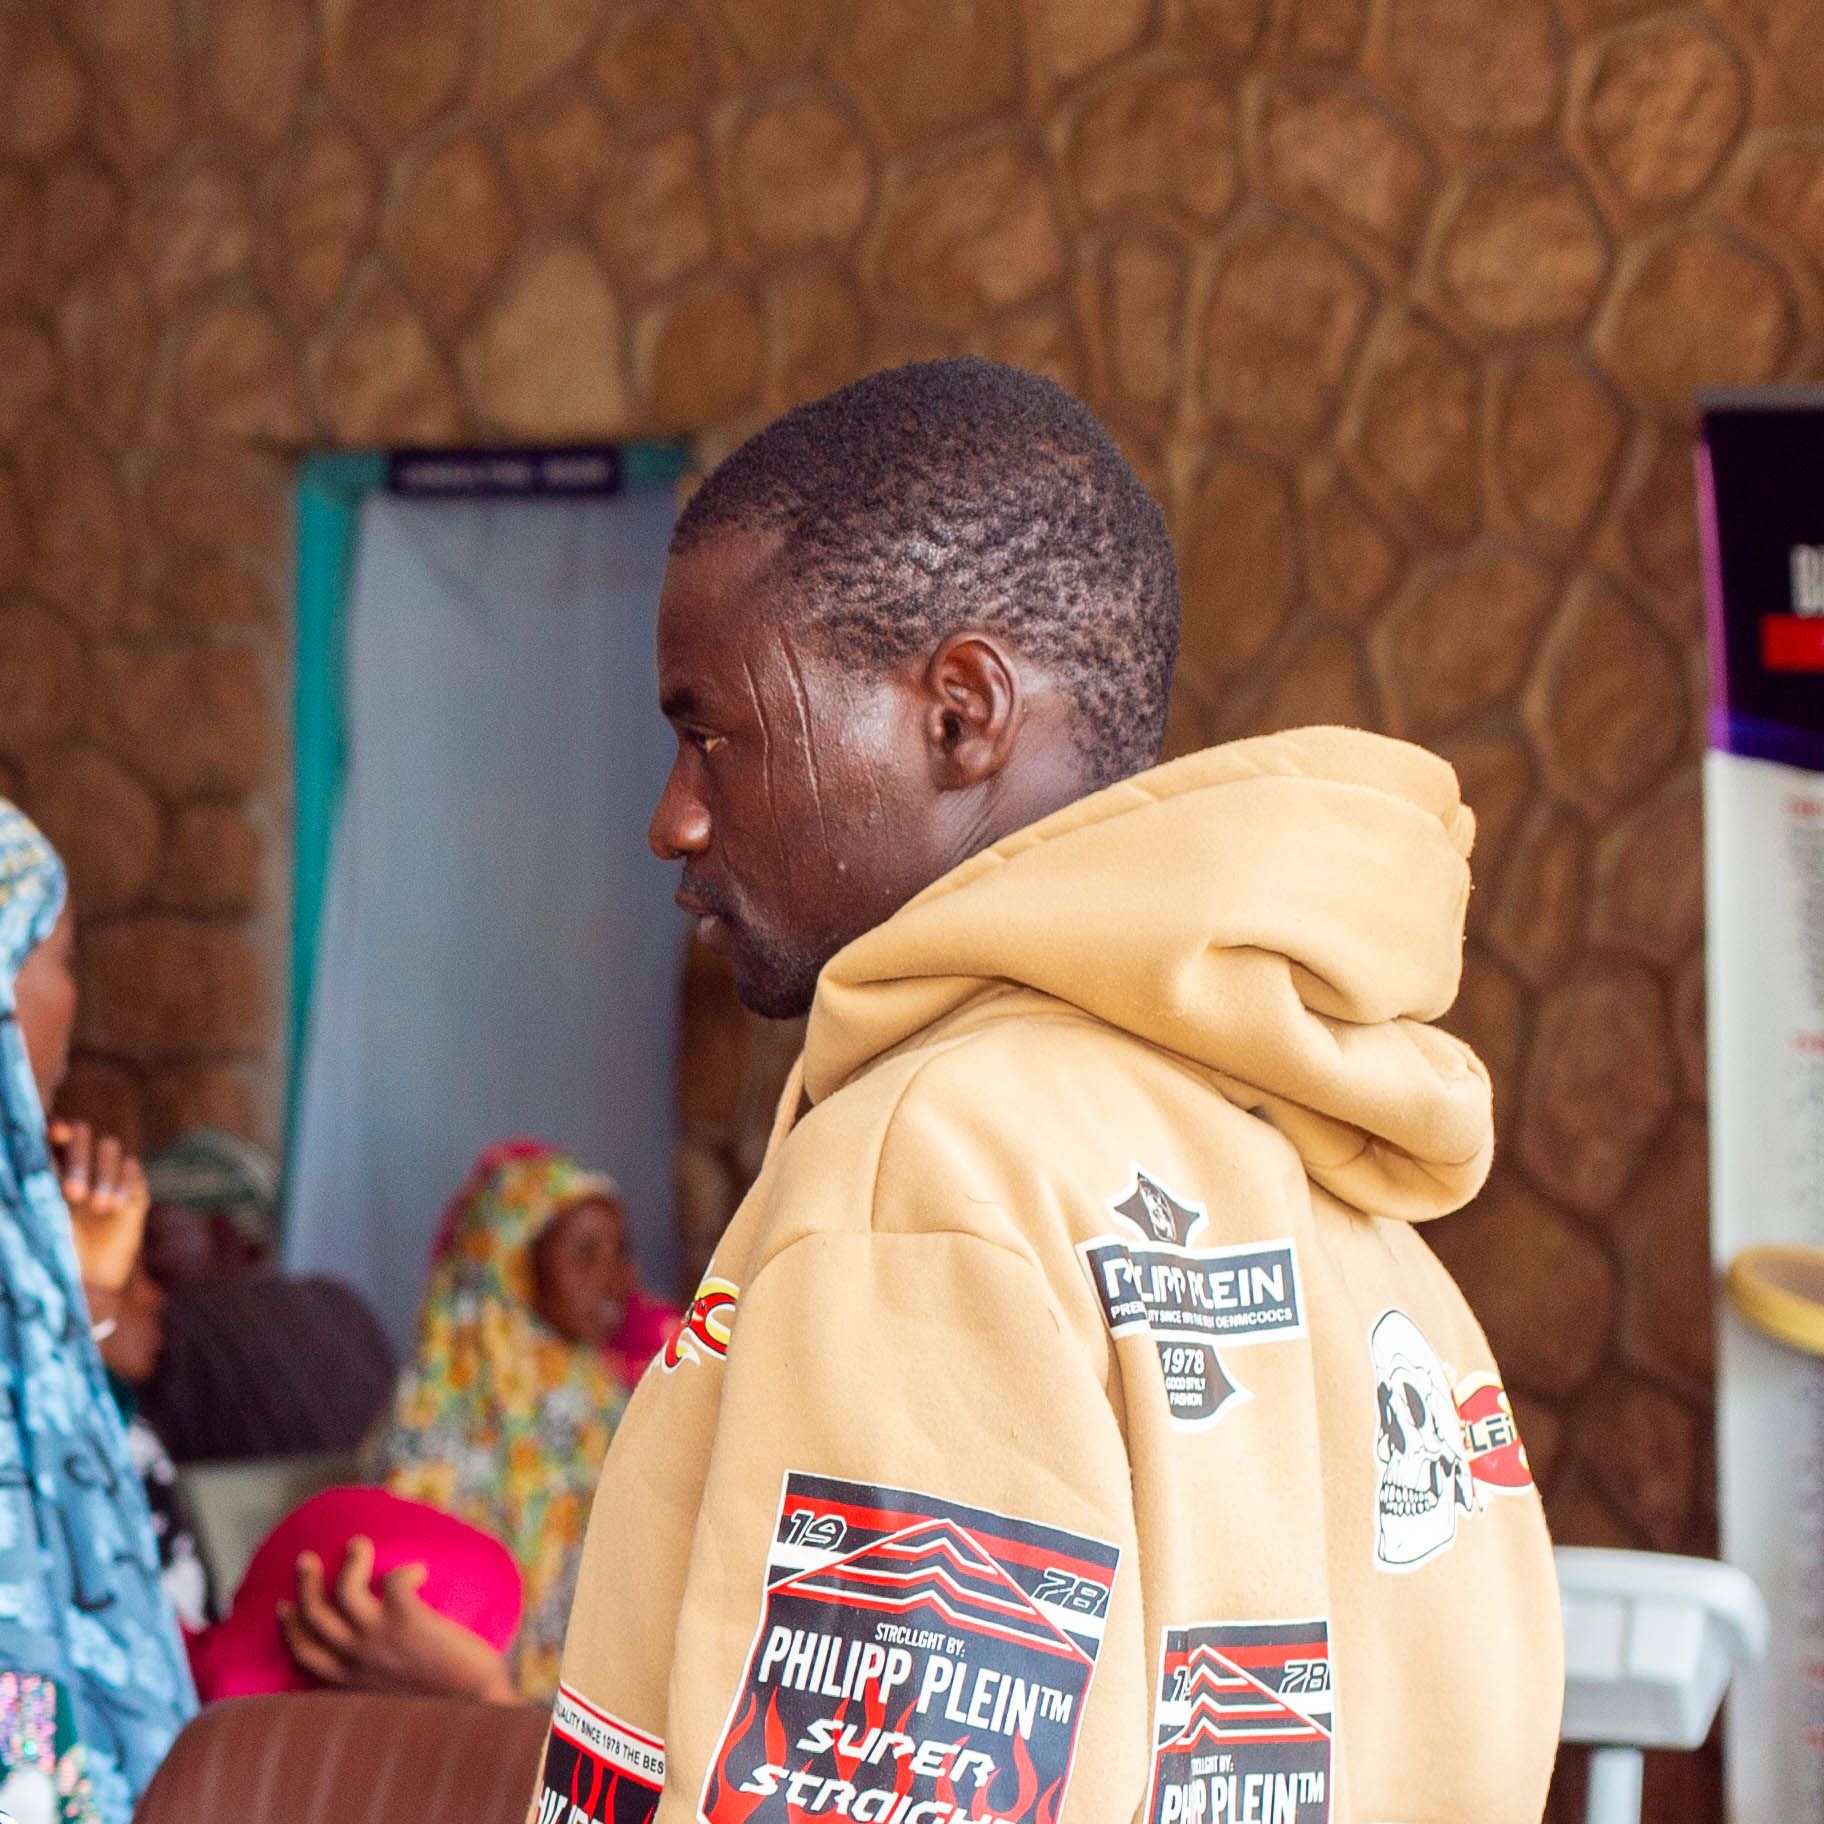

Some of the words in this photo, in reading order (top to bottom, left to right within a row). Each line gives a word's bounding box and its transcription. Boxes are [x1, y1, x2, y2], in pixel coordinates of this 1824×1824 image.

[1162, 1348, 1205, 1374] 1978
[784, 1510, 848, 1550] 19
[1030, 1568, 1110, 1616] 78
[758, 1625, 912, 1704] PHILIPP
[946, 1637, 966, 1658] BY:
[1278, 1658, 1330, 1696] 78
[581, 1718, 602, 1745] SINCE
[602, 1734, 621, 1756] 1978
[623, 1744, 643, 1767] THE
[643, 1752, 665, 1775] BES
[796, 1717, 997, 1787] SUPER
